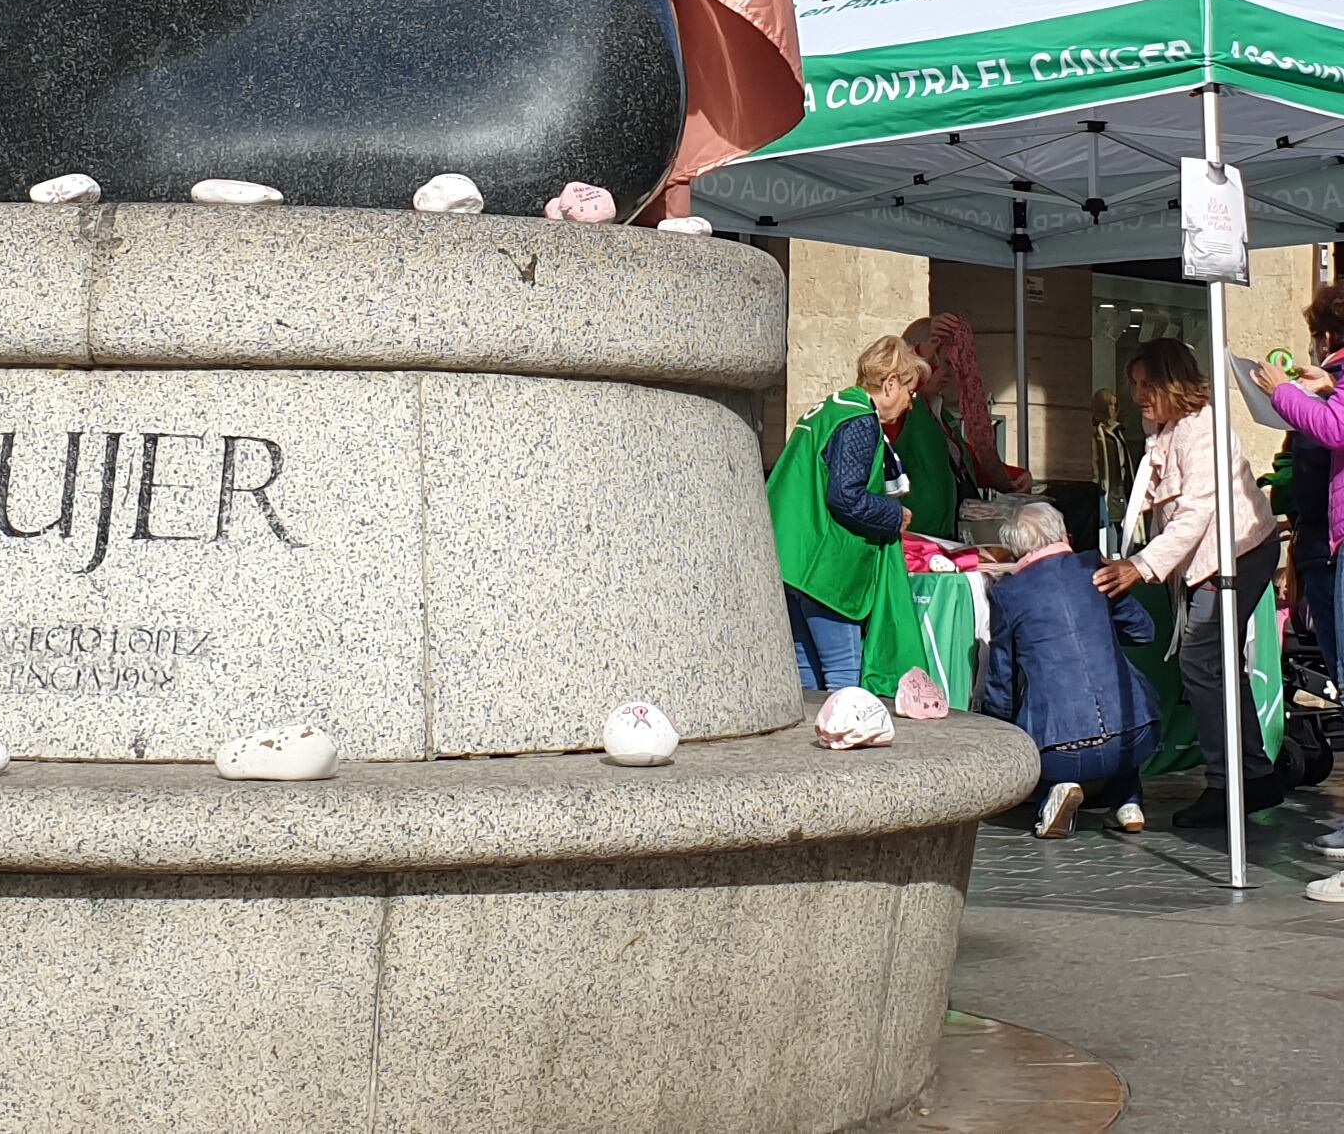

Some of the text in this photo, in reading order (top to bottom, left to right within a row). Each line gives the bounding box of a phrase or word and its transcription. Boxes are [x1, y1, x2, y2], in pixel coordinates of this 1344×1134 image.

[800, 5, 834, 18] en
[825, 65, 971, 110] CONTRA
[975, 58, 1024, 89] EL
[1029, 39, 1193, 82] CÁNCER
